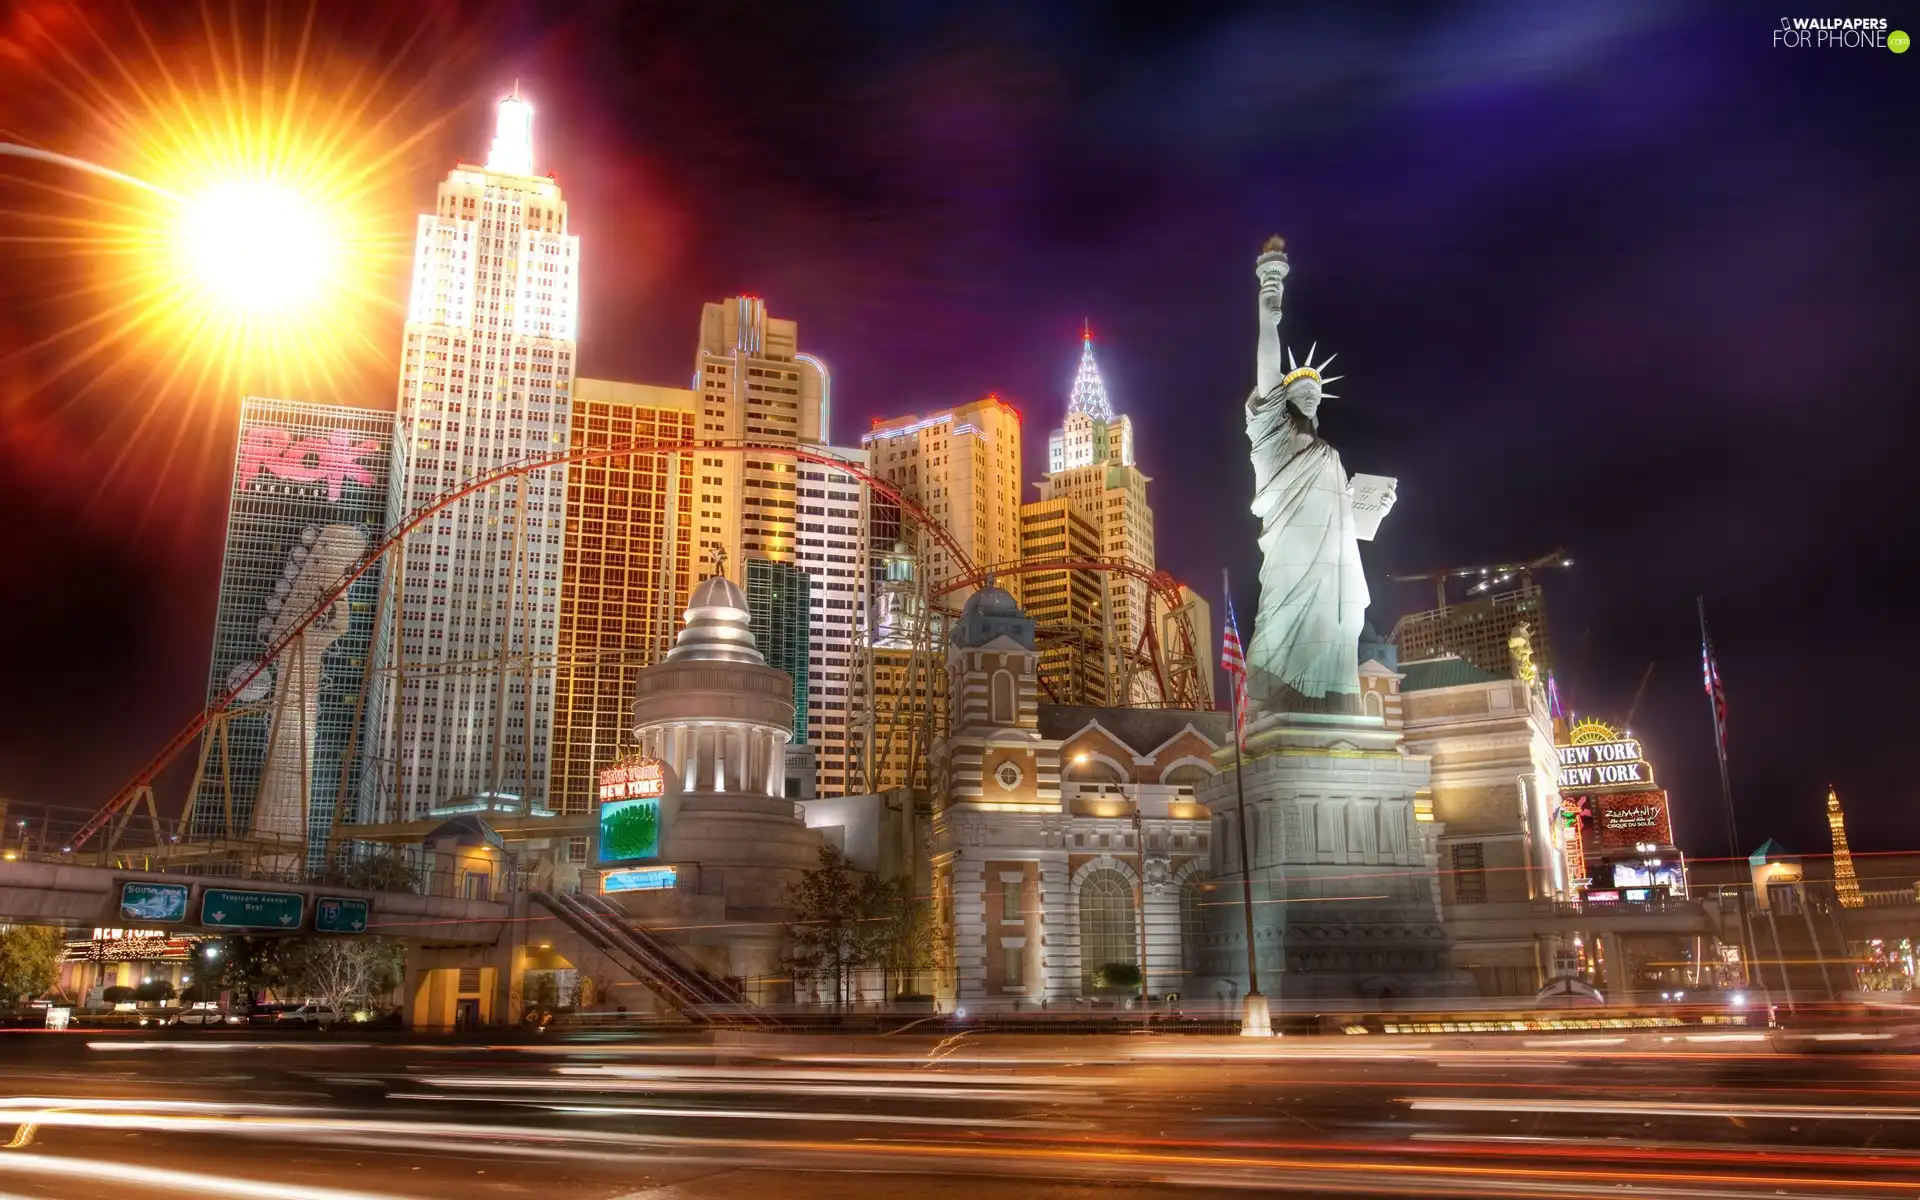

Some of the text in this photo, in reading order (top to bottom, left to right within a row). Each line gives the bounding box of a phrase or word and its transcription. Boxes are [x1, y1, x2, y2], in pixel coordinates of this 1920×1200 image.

[1557, 742, 1639, 764] NEW YORK
[601, 766, 659, 784] NEW YORK
[1557, 764, 1641, 786] NEW YORK
[600, 779, 659, 798] NEW YORK
[1605, 805, 1661, 818] ZUMANITY
[324, 905, 337, 919] 15
